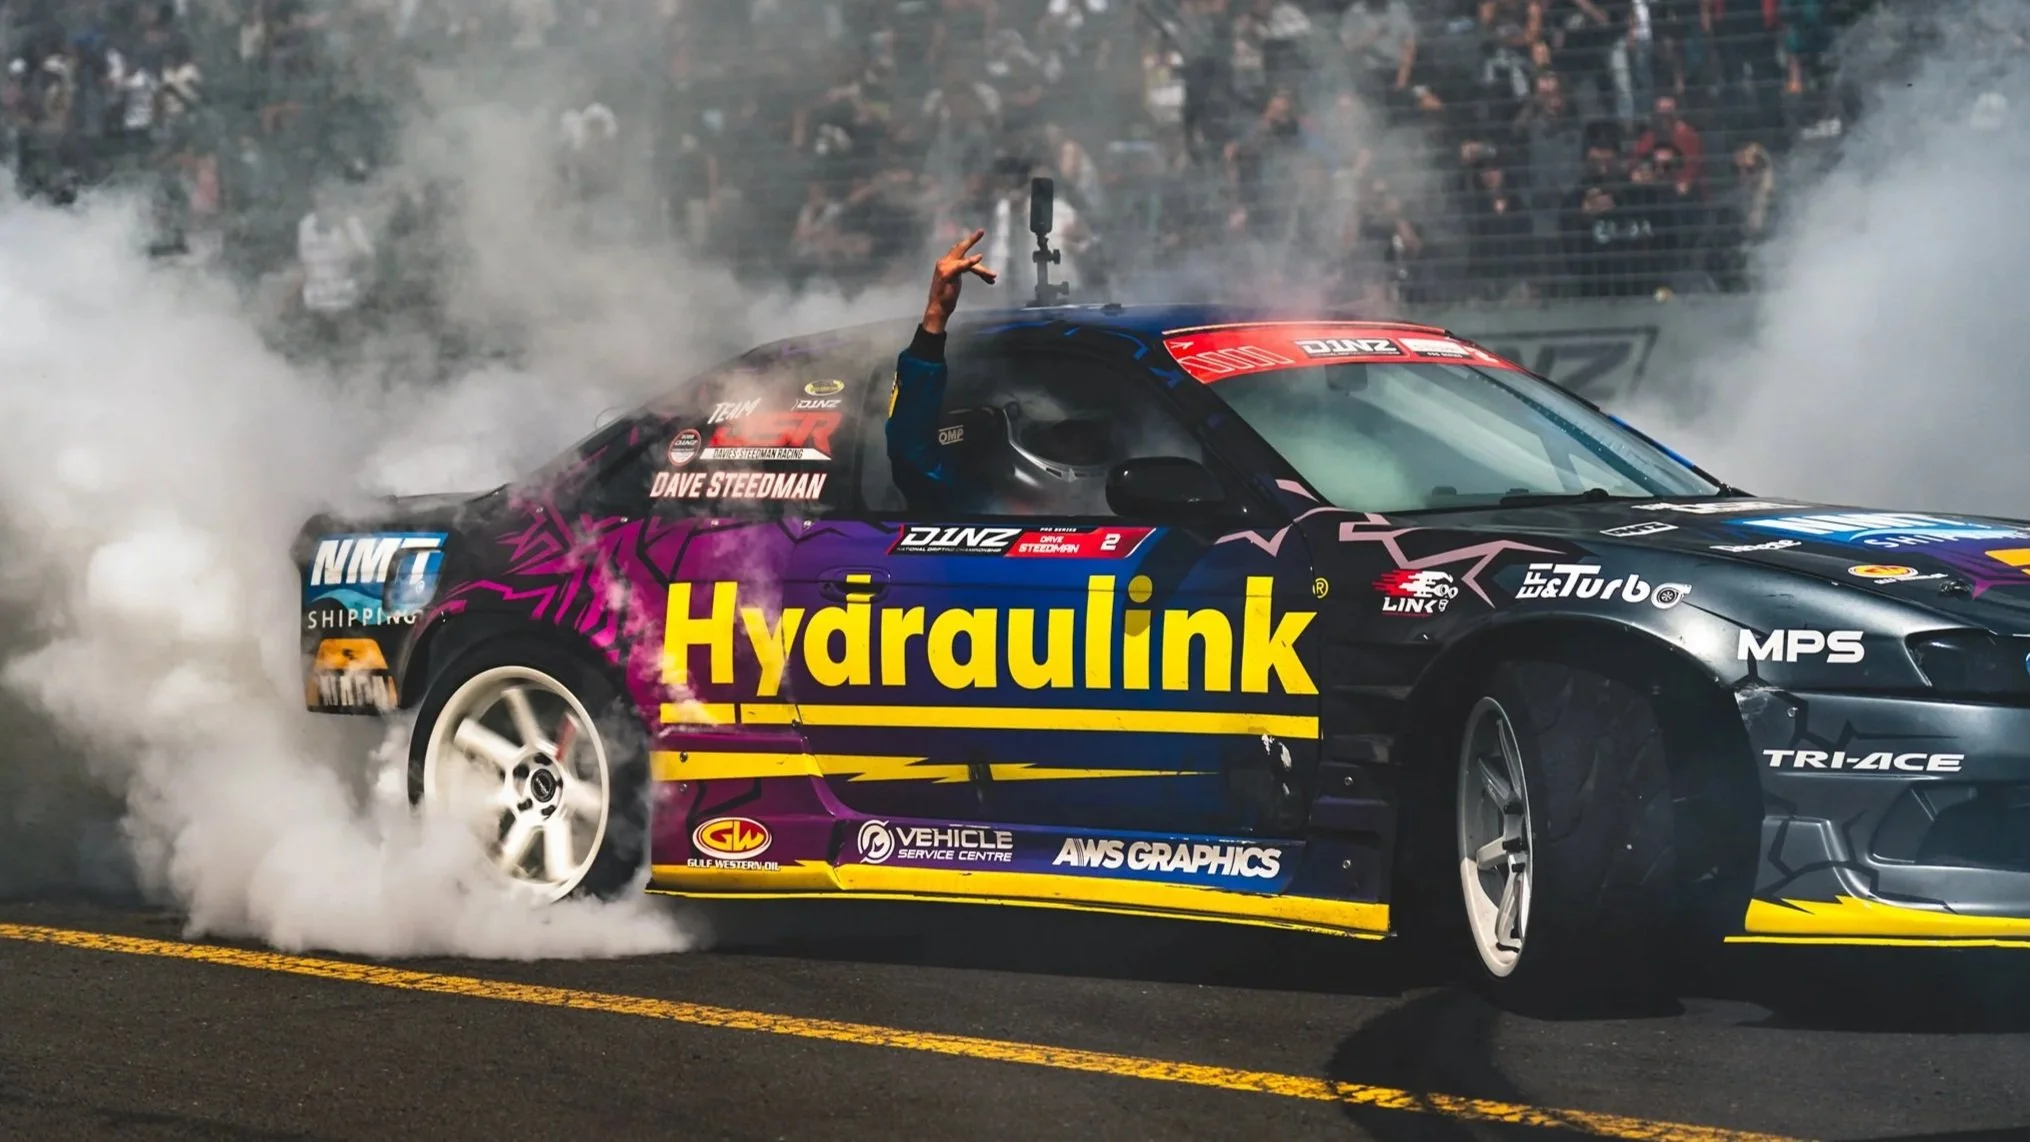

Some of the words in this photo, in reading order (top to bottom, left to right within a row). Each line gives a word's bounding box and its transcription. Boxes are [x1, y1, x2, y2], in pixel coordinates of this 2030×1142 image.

[707, 397, 761, 425] TEAM
[939, 428, 964, 442] OMP
[650, 471, 703, 498] DAVE
[707, 472, 827, 499] STEEDMAN
[900, 527, 1022, 547] D1NZ
[1019, 543, 1080, 553] STEEDMAN
[1100, 533, 1121, 551] 2
[310, 538, 441, 586] NMT
[1382, 597, 1437, 613] LINK
[308, 607, 424, 629] SHIPPING
[660, 575, 1320, 696] Hydraulink
[1737, 629, 1865, 663] MPS
[1763, 749, 1965, 772] TRI-ACE
[701, 820, 765, 852] GW
[896, 826, 1013, 851] VEHICLE
[687, 858, 713, 868] GULF
[715, 859, 762, 870] WESTERN
[764, 861, 781, 871] OIL
[897, 849, 954, 860] SERVICE
[958, 850, 1013, 862] CENTRE
[1052, 838, 1125, 869] AWS
[1127, 841, 1283, 879] GRAPHICS
